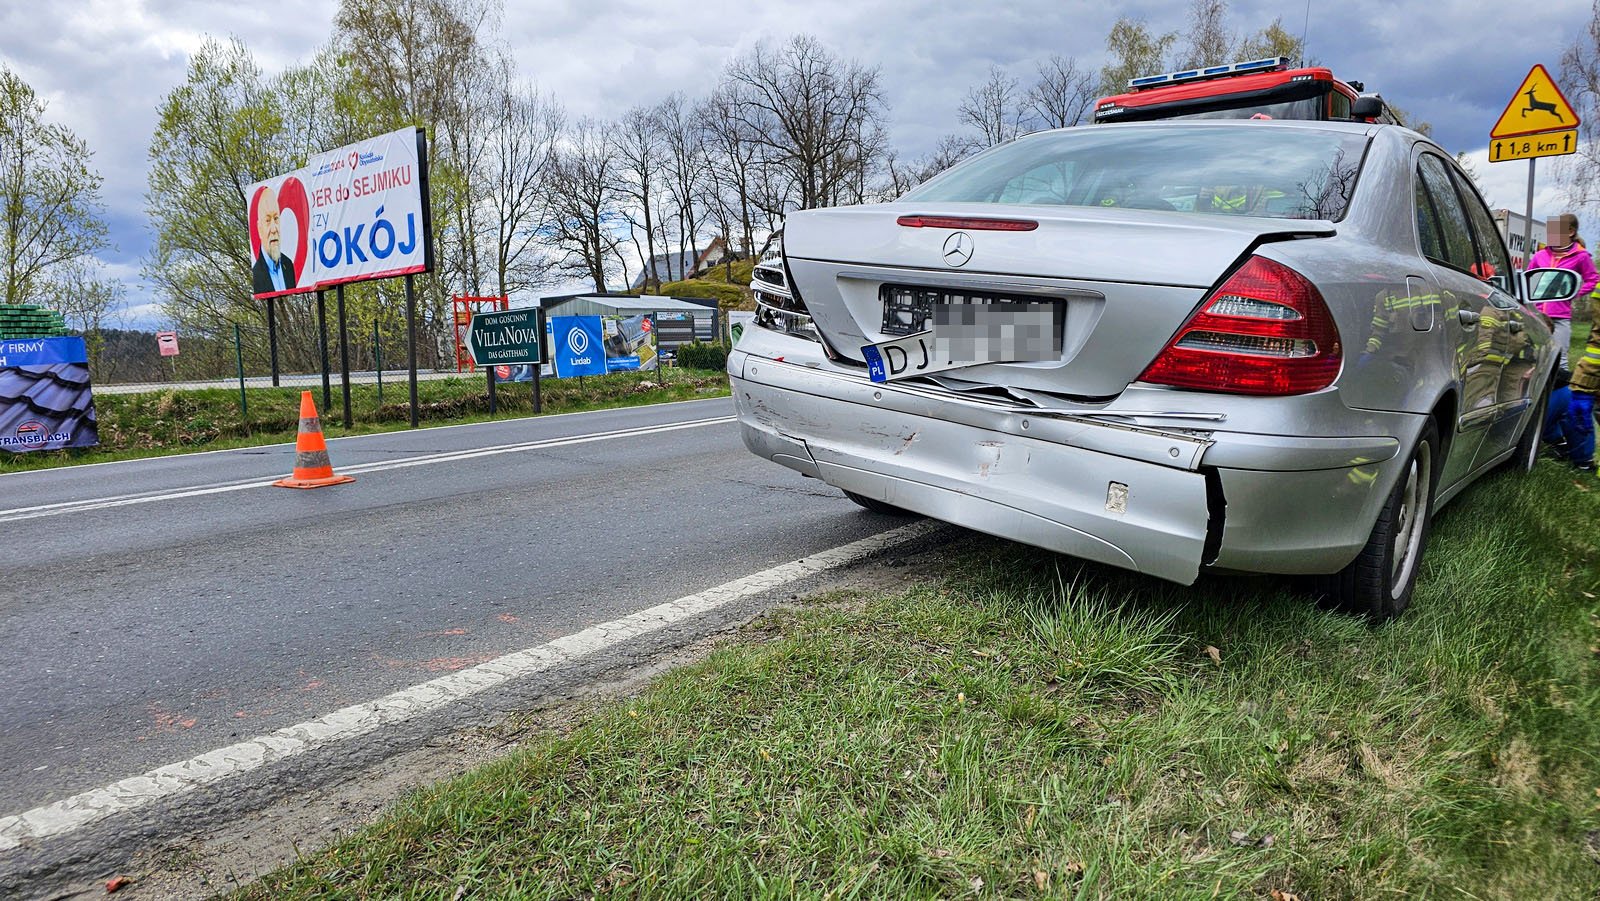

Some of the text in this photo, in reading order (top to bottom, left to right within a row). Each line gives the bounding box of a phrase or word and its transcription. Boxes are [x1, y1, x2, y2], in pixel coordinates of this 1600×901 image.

[1510, 141, 1558, 156] 1,8 km
[335, 183, 350, 203] do
[353, 164, 411, 198] SEJMIKU
[312, 212, 330, 231] zy
[484, 313, 528, 326] DOM GOŚCINNY
[9, 341, 45, 353] FIRMY
[488, 348, 529, 359] DAS GÄSTEHAUS
[570, 356, 592, 366] Lindab
[871, 366, 884, 377] PL
[0, 432, 71, 446] TRANSBLACH
